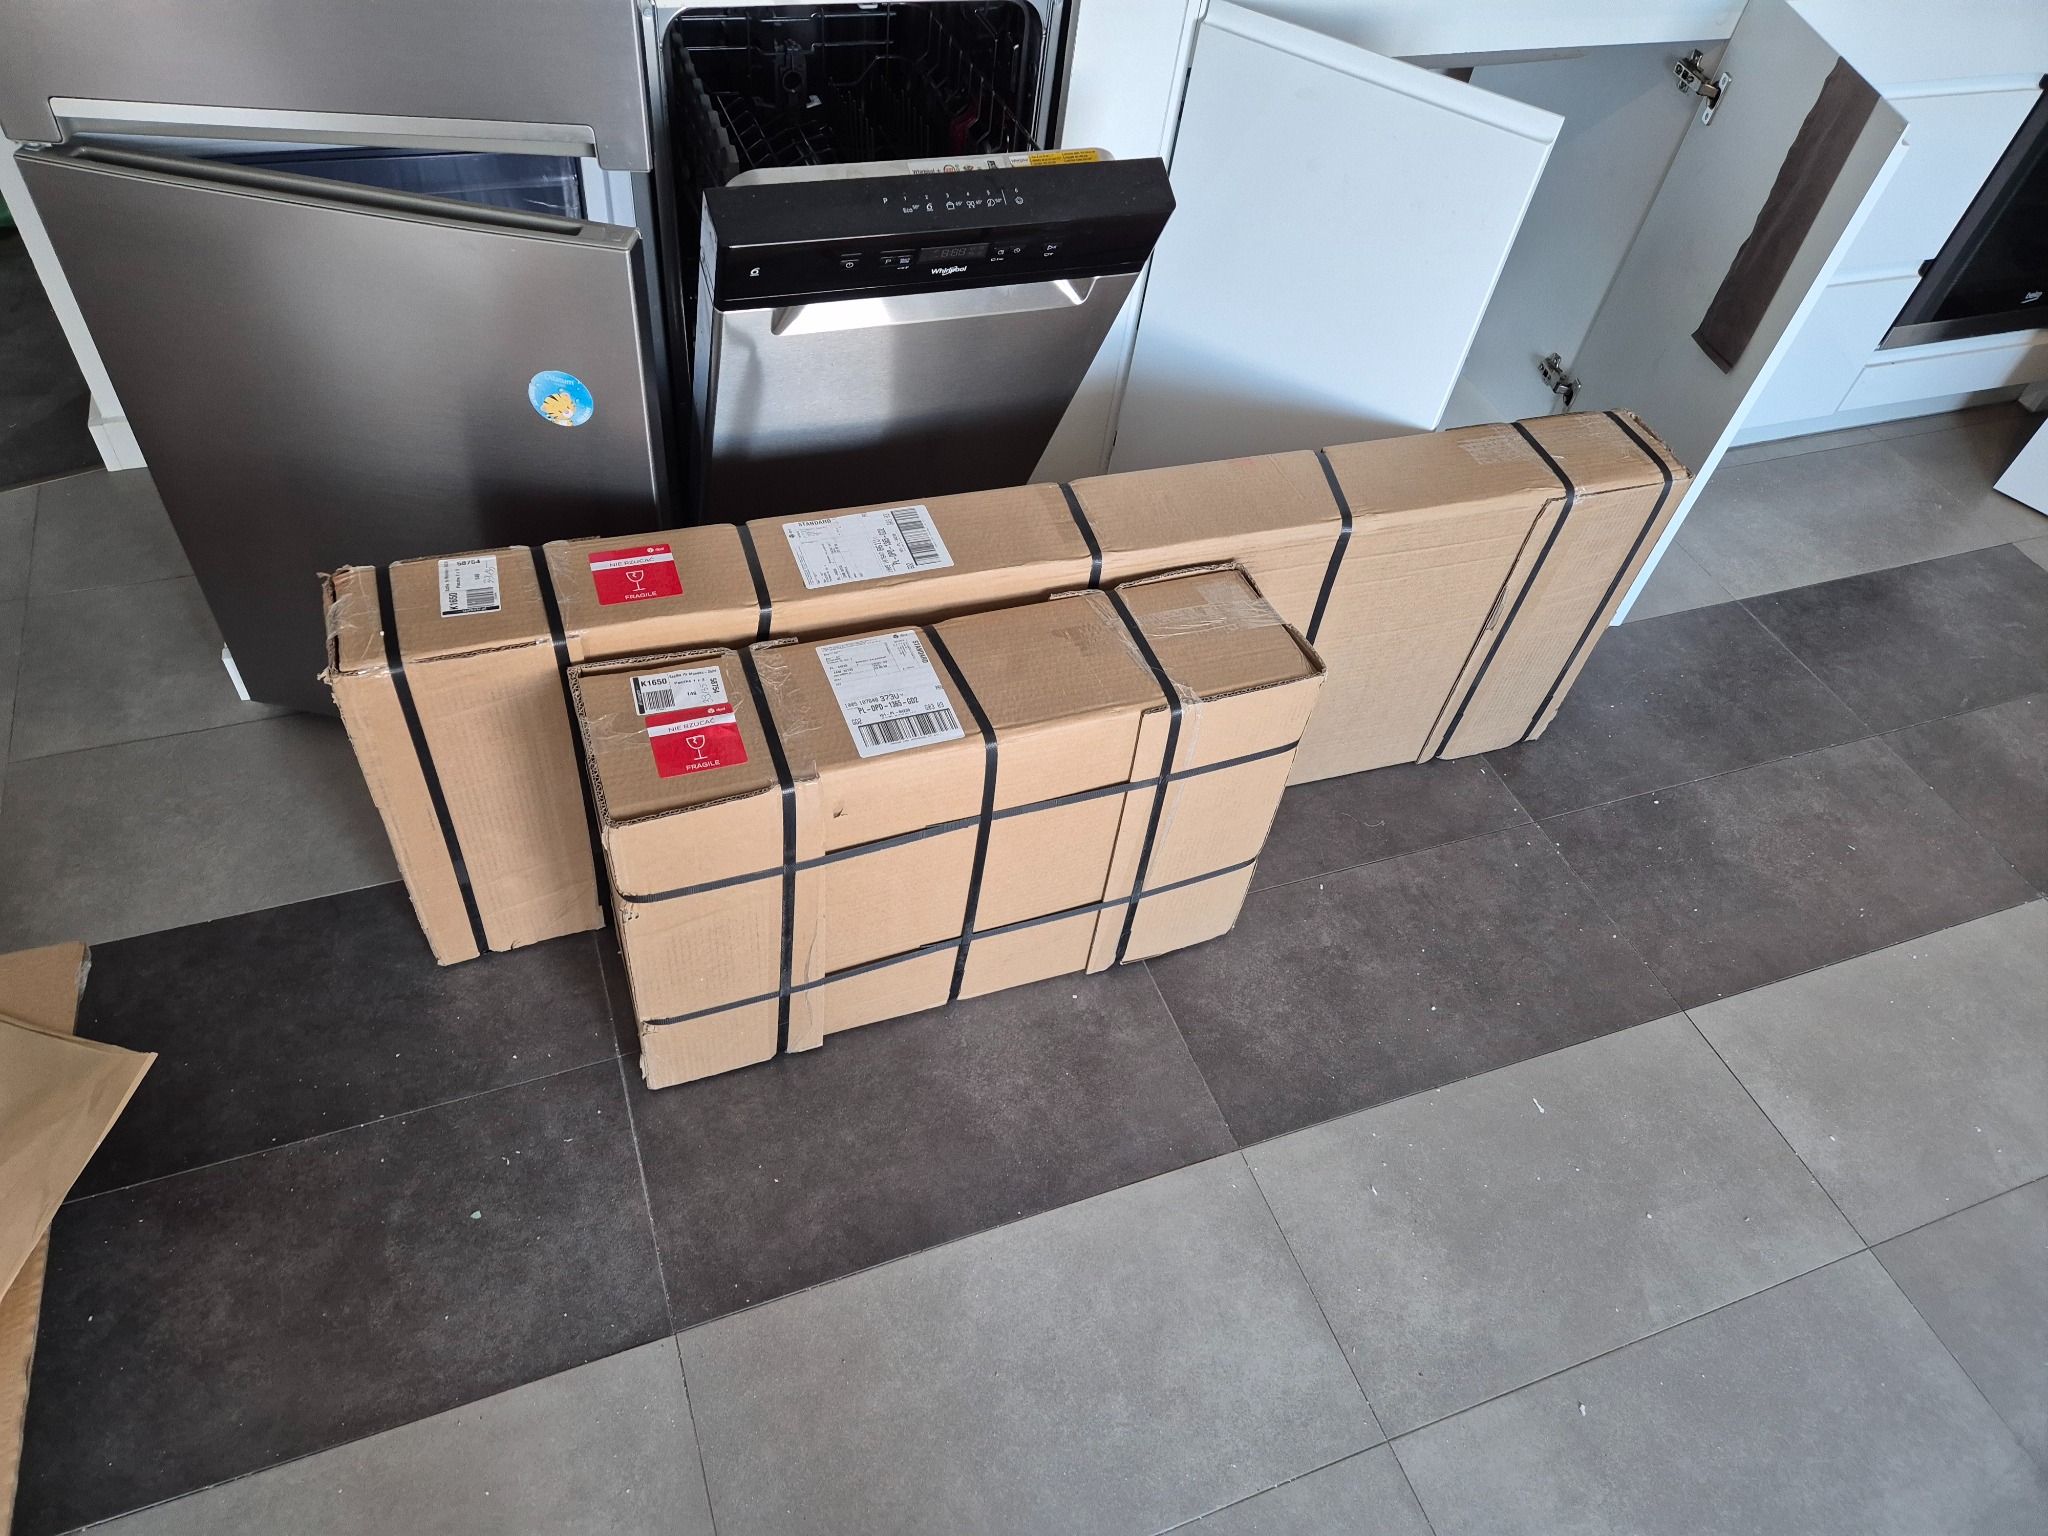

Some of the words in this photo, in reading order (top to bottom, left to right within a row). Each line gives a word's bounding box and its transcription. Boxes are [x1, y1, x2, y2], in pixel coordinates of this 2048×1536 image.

[931, 265, 968, 276] Whirlpool
[544, 373, 575, 386] Oilatum
[797, 518, 832, 527] STANDARD
[624, 556, 655, 566] RZUCAĆ
[448, 592, 459, 610] K1650
[625, 591, 657, 600] FRAGILE
[912, 640, 929, 664] STANDARD
[640, 677, 668, 688] K1650
[668, 724, 682, 733] NIE
[683, 717, 716, 730] RZUCAĆ
[686, 760, 720, 771] FRAGILE
